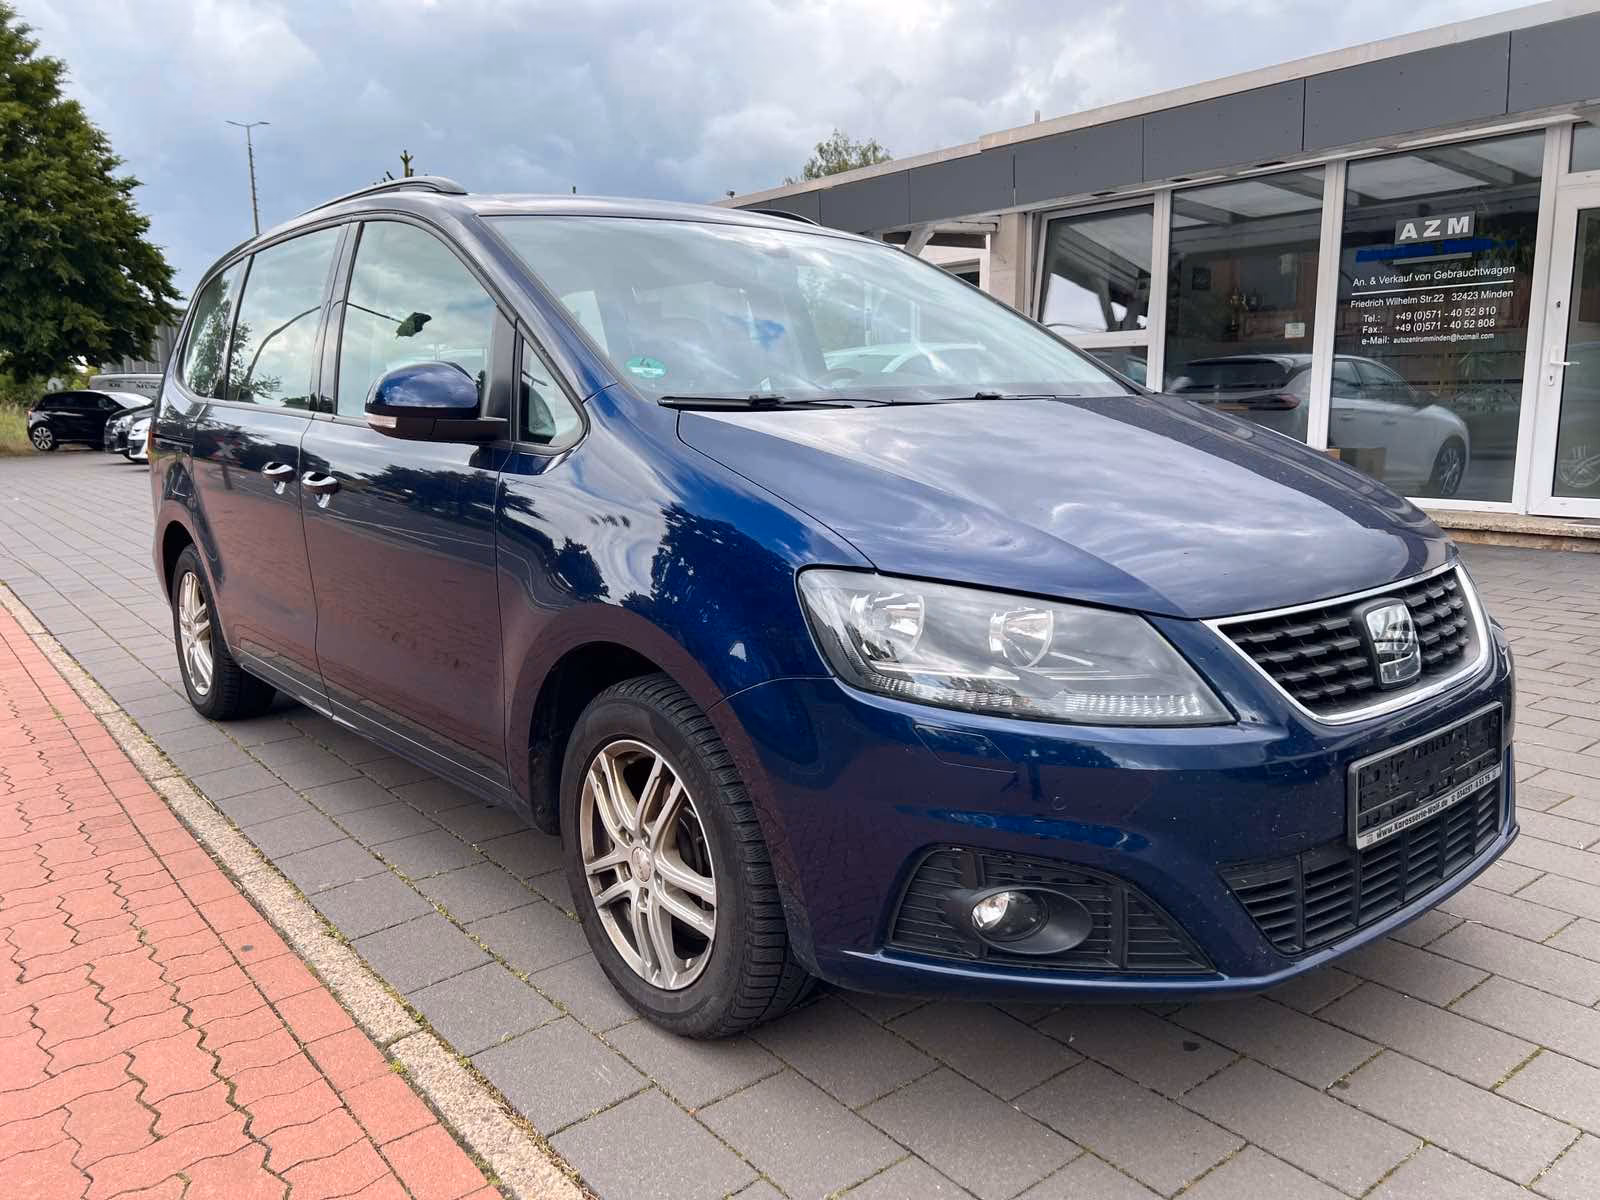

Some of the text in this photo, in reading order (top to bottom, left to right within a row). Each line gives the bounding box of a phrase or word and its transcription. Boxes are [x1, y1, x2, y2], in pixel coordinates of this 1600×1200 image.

[1352, 265, 1516, 287] An. & Verkauf von Gebrauchtwagen
[1350, 289, 1514, 309] Friedrich Wilhelm Str.22 32423 Minden
[1395, 311, 1412, 321] +49
[1413, 308, 1441, 322] (0)571
[1450, 308, 1462, 318] 40
[1464, 307, 1476, 317] 52
[1478, 306, 1497, 315] 810
[1395, 323, 1412, 333] +49
[1413, 320, 1441, 333] (0)571
[1449, 320, 1461, 330] 40
[1463, 319, 1476, 329] 52
[1477, 318, 1495, 328] 808
[1361, 336, 1390, 345] e-Mail:
